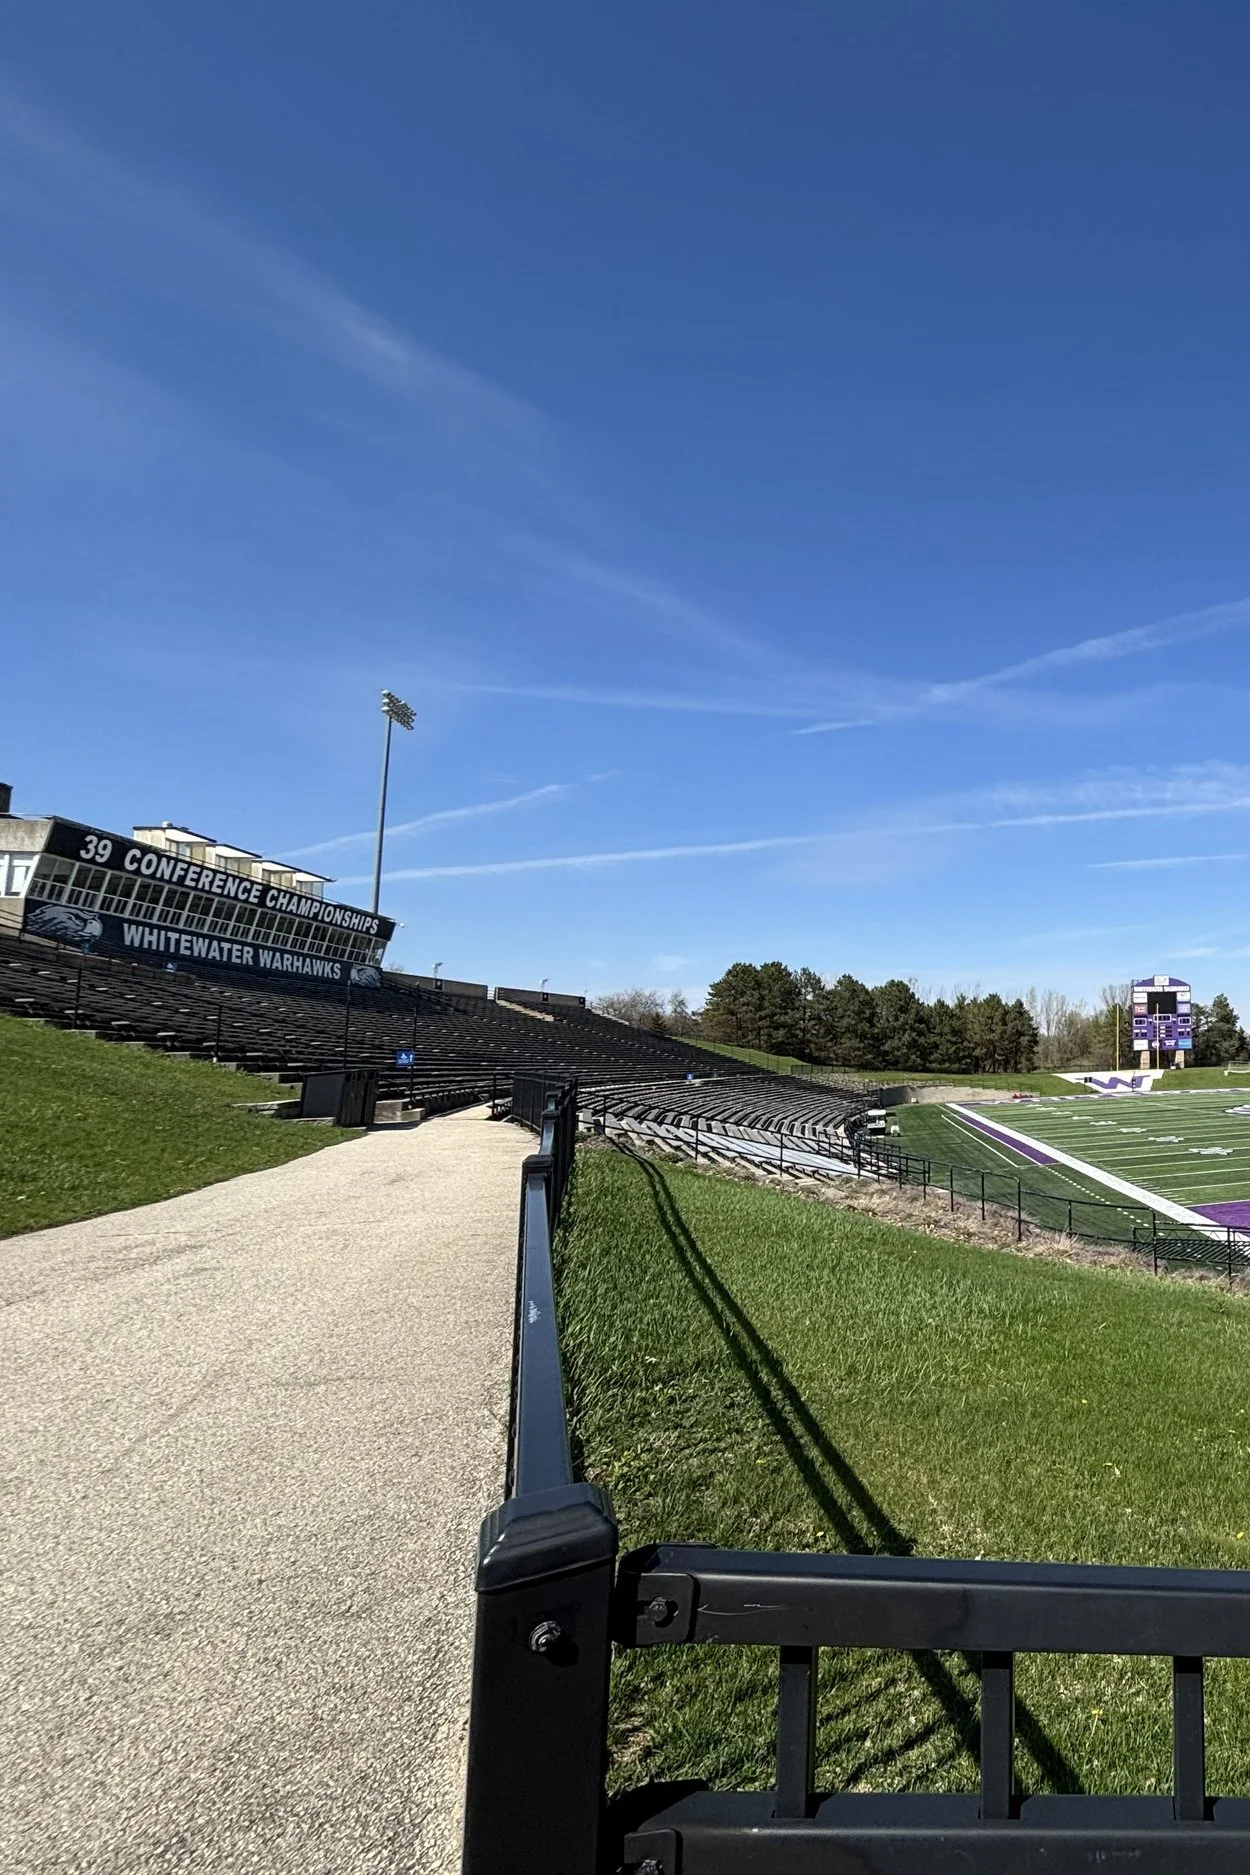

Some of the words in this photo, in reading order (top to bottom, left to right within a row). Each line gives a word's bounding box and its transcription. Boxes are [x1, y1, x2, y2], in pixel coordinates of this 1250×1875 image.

[80, 834, 113, 864] 39
[123, 848, 263, 904] CONFERENCE
[265, 889, 380, 935] CHAMPIONSHIPS
[123, 923, 254, 966] WHITEWATER
[259, 948, 342, 980] WARHAWKS
